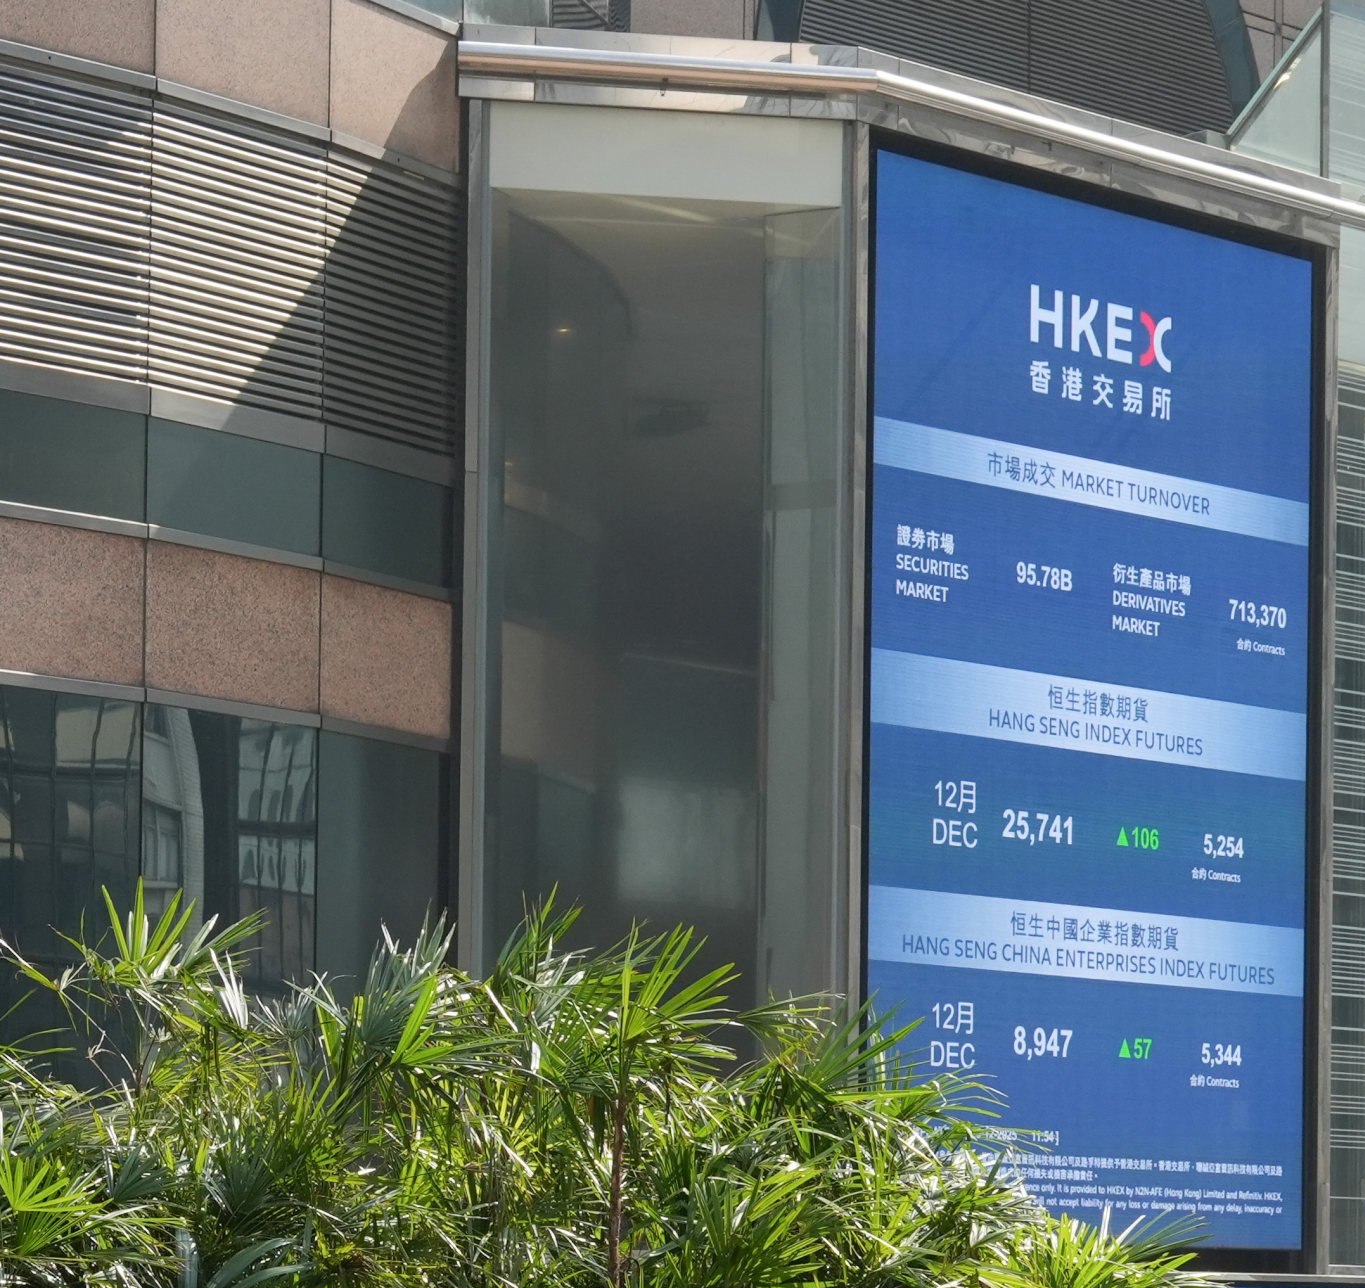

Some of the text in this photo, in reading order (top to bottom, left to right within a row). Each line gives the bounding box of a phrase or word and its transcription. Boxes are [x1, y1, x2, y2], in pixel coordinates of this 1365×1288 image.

[1030, 285, 1171, 372] HKEX
[1030, 361, 1171, 420] 香港交易所
[988, 452, 1209, 515] 市場成交 MARKET TURNOVER
[896, 554, 969, 580] SECURITIES
[1017, 562, 1072, 591] 95.78B
[1113, 563, 1191, 596] 衍生產品市場
[896, 579, 949, 602] MARKET
[1113, 591, 1185, 616] DERIVATIVES
[1113, 615, 1160, 636] MARKET
[1229, 599, 1286, 628] 713,370
[1253, 642, 1285, 655] Contracts
[1048, 685, 1148, 722] 恒生指數期貨
[989, 708, 1203, 756] HANG SENG INDEX FUTURES
[935, 781, 976, 813] 12月
[933, 819, 977, 848] DEC
[1003, 809, 1072, 845] 25,741
[1132, 827, 1159, 849] 106
[1204, 834, 1244, 858] 5,254
[1208, 870, 1241, 882] Contracts
[1011, 912, 1178, 951] 恒生中國企業指數期貨
[903, 934, 1275, 985] HANG SENG CHINA ENTERPRISES INDEX FUTURES
[932, 1002, 973, 1034] 12月
[929, 1038, 977, 1069] DEC
[1014, 1026, 1072, 1060] 8,947
[1134, 1038, 1152, 1059] 57
[1202, 1043, 1242, 1067] 5,344
[1206, 1076, 1239, 1088] Contracts
[1041, 1184, 1056, 1194] only.
[1070, 1184, 1096, 1195] provided
[1098, 1186, 1105, 1194] to
[1107, 1186, 1125, 1194] HKEX
[1126, 1186, 1134, 1197] by
[1203, 1190, 1224, 1198] Limited
[1226, 1190, 1237, 1199] and
[1046, 1198, 1057, 1206] not
[1116, 1201, 1126, 1210] any
[1128, 1200, 1140, 1208] loss
[1214, 1204, 1224, 1214] any
[1276, 1206, 1282, 1214] or
